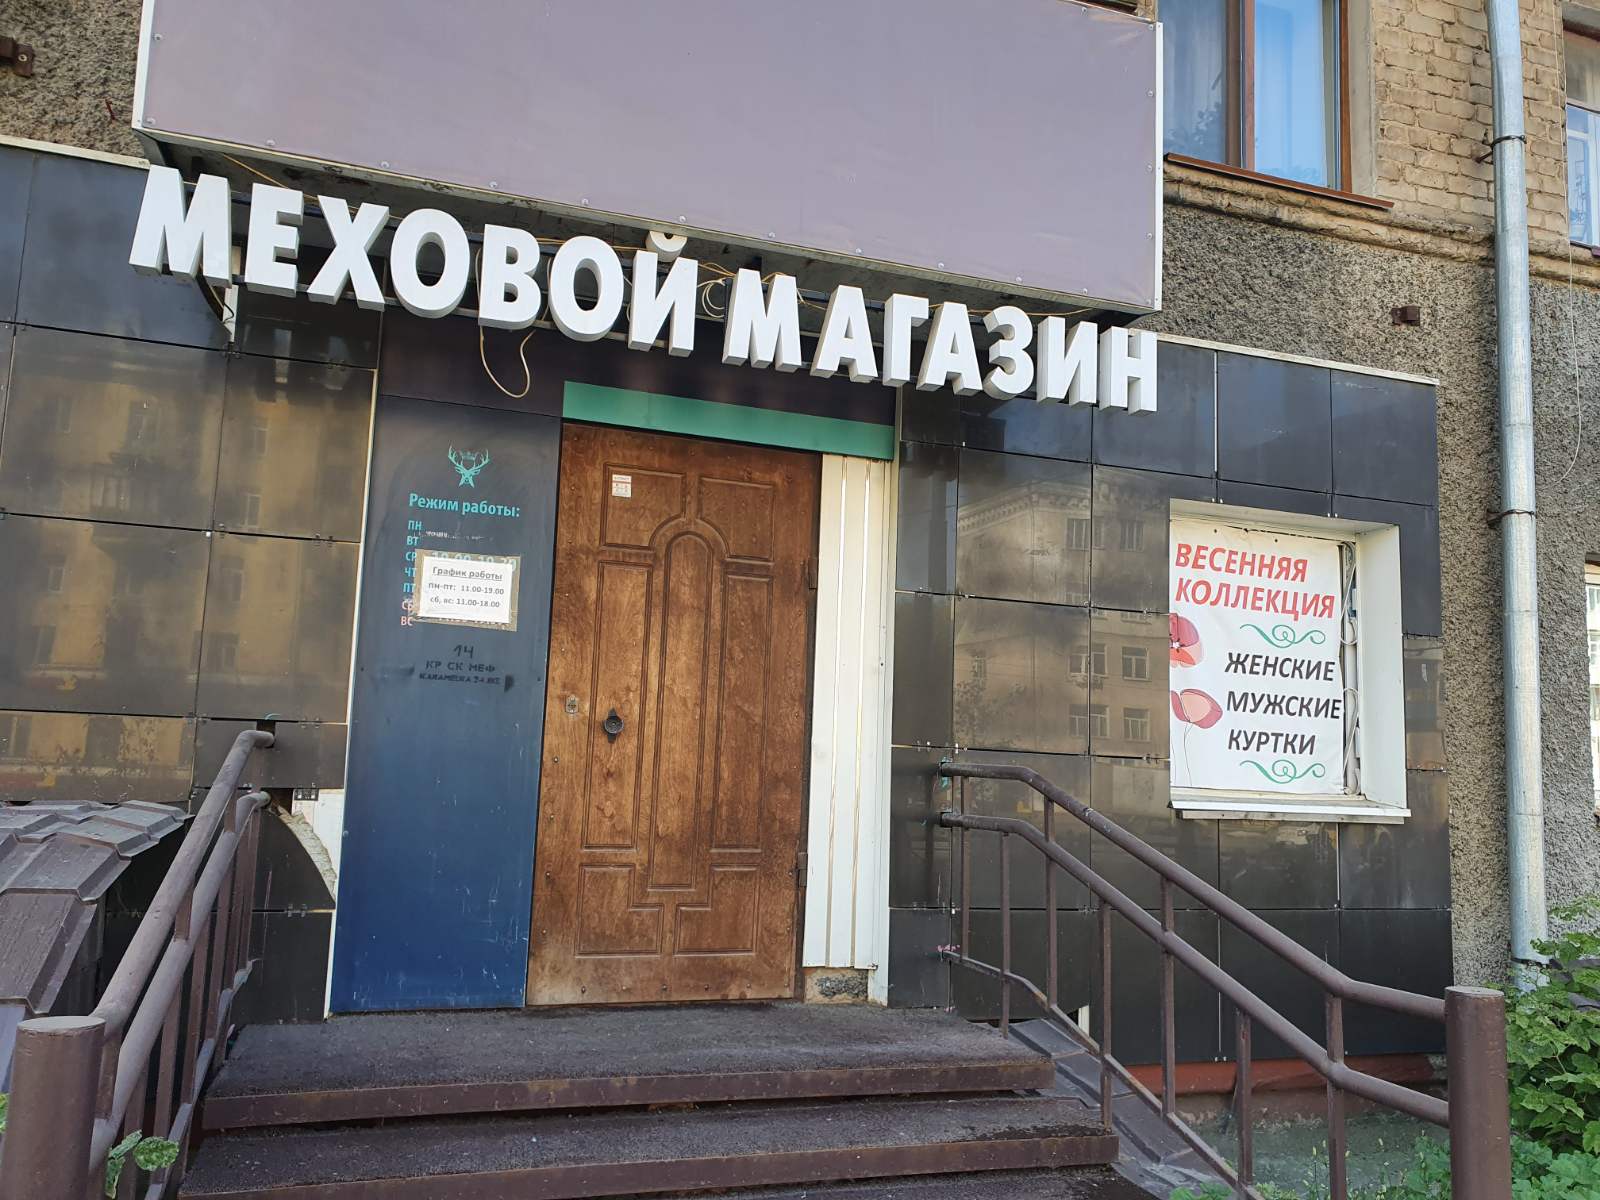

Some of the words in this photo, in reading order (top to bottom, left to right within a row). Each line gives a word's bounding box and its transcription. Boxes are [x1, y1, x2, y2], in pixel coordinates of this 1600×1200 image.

[129, 163, 698, 357] МЕХОВОЙ
[722, 267, 1158, 415] МАГАЗИН
[409, 493, 458, 511] Режим
[462, 501, 520, 518] работы:
[408, 520, 422, 531] ПН
[406, 536, 420, 546] ВТ
[405, 551, 416, 561] СР
[1175, 543, 1308, 583] ВЕСЕННЯЯ
[432, 566, 467, 577] График
[469, 571, 503, 581] работы
[461, 585, 505, 595] 11.00-19.00
[1174, 577, 1335, 622] КОЛЛЕКЦИЯ
[400, 615, 413, 626] ВС
[1224, 652, 1335, 682] ЖЕНСКИЕ
[1226, 690, 1342, 720] МУЖСКИЕ
[1227, 729, 1316, 756] КУРТКИ
